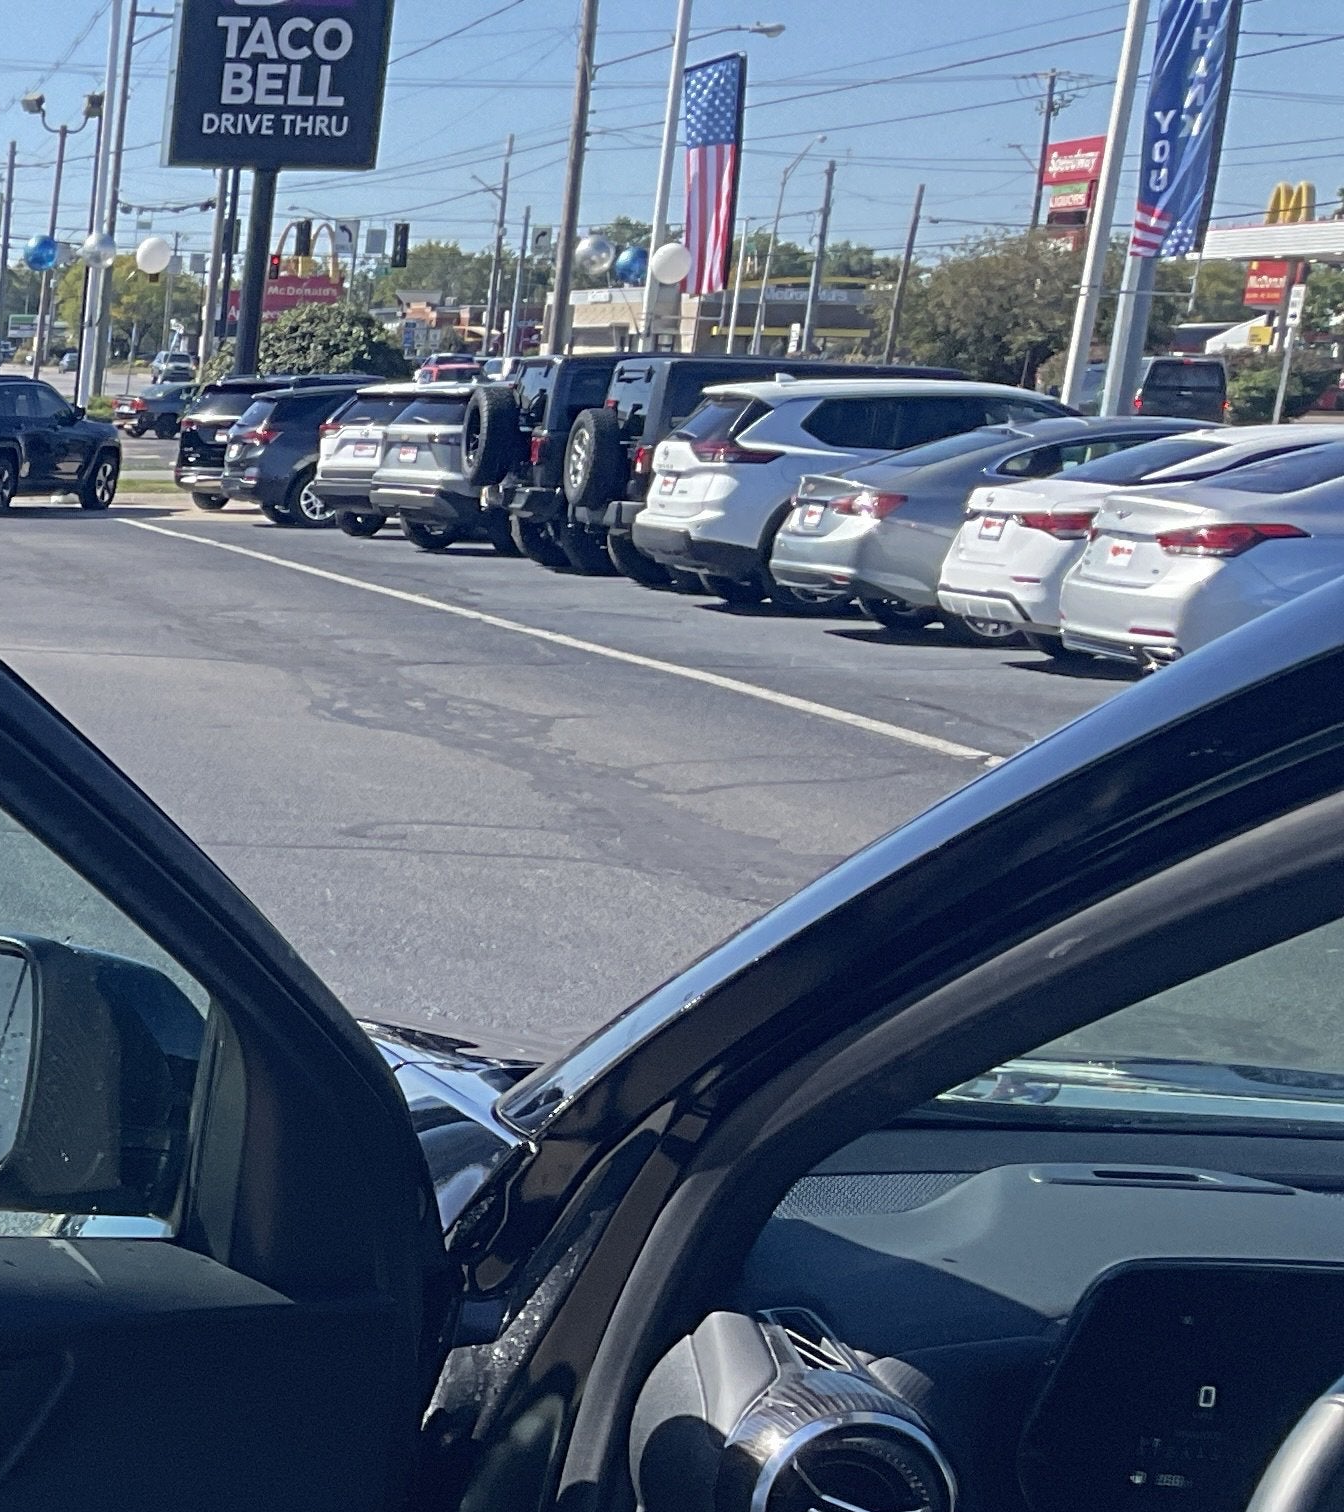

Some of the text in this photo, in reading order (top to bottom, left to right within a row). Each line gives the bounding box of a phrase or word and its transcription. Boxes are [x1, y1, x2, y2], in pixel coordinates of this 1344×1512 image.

[217, 16, 354, 61] TACO
[220, 63, 345, 107] BELL
[1178, 0, 1220, 138] THANK
[202, 113, 349, 137] DRIVE THRU
[1048, 148, 1100, 178] Speedway
[1149, 109, 1177, 192] YOU
[267, 286, 338, 296] McDonald's
